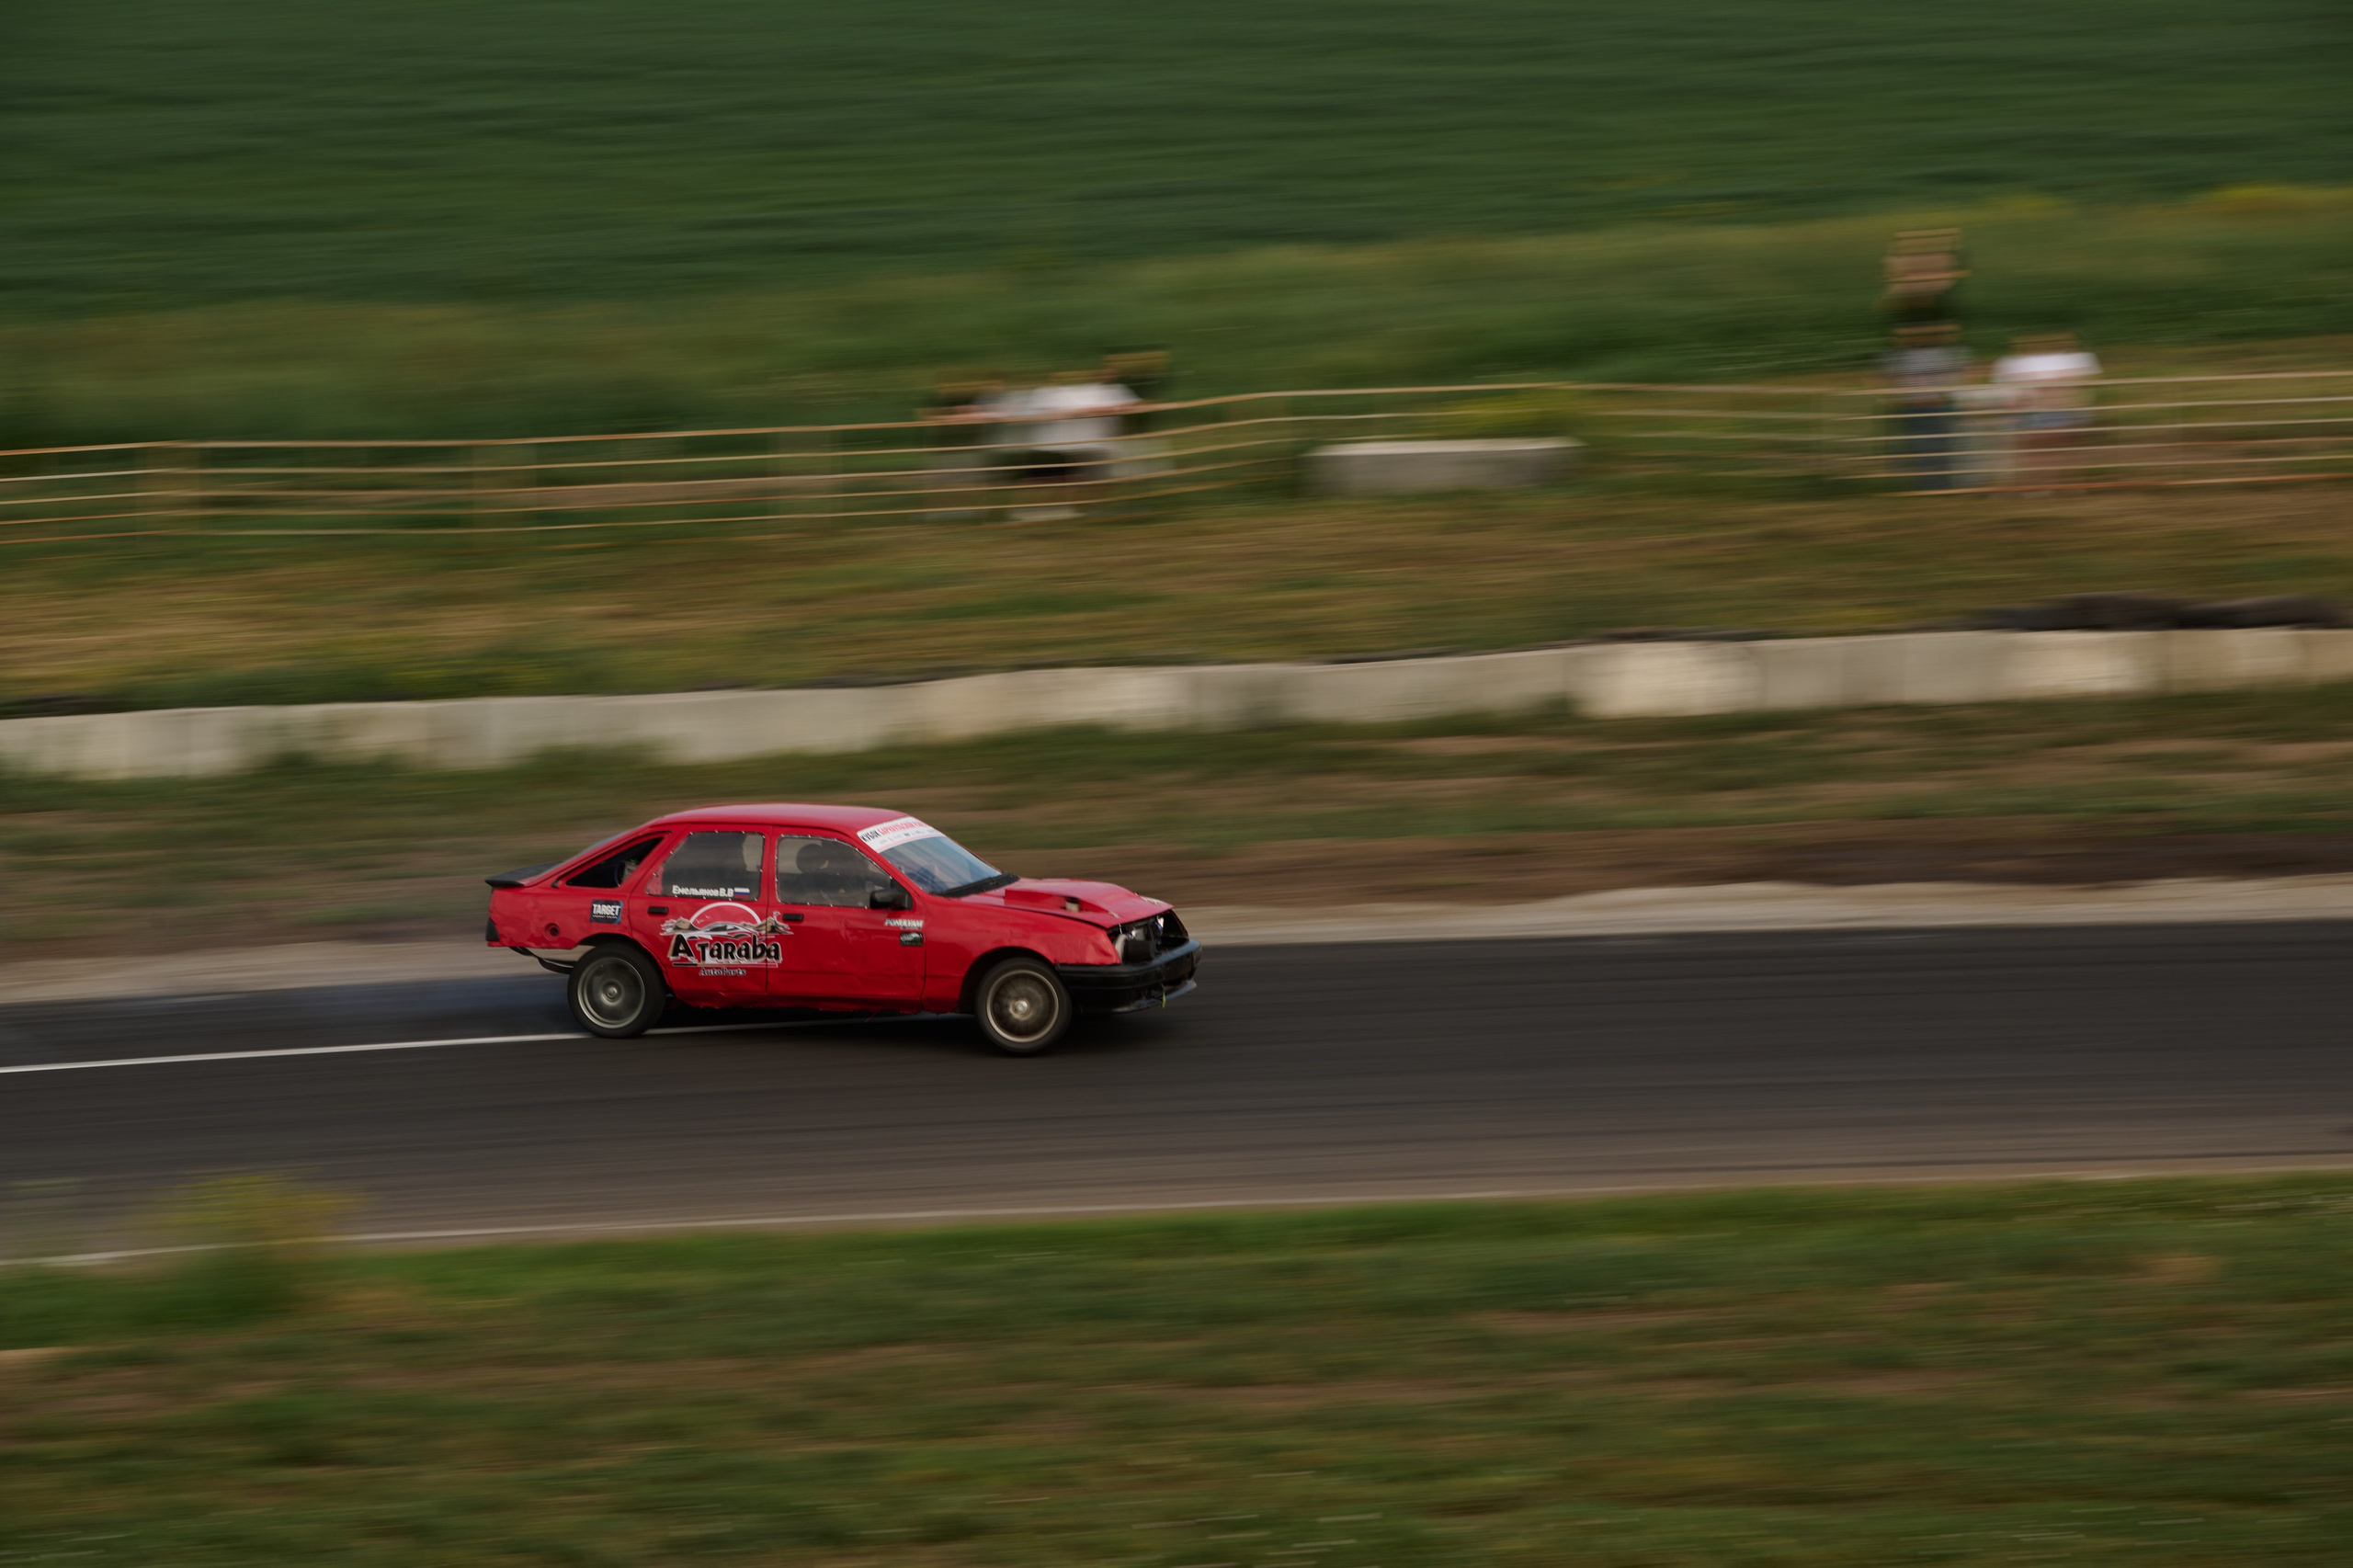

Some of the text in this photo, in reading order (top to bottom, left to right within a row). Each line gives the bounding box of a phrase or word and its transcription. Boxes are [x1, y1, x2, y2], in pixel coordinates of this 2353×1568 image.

[860, 830, 881, 843] КУБОК
[593, 903, 621, 915] TARGET
[699, 968, 746, 976] AutoParts
